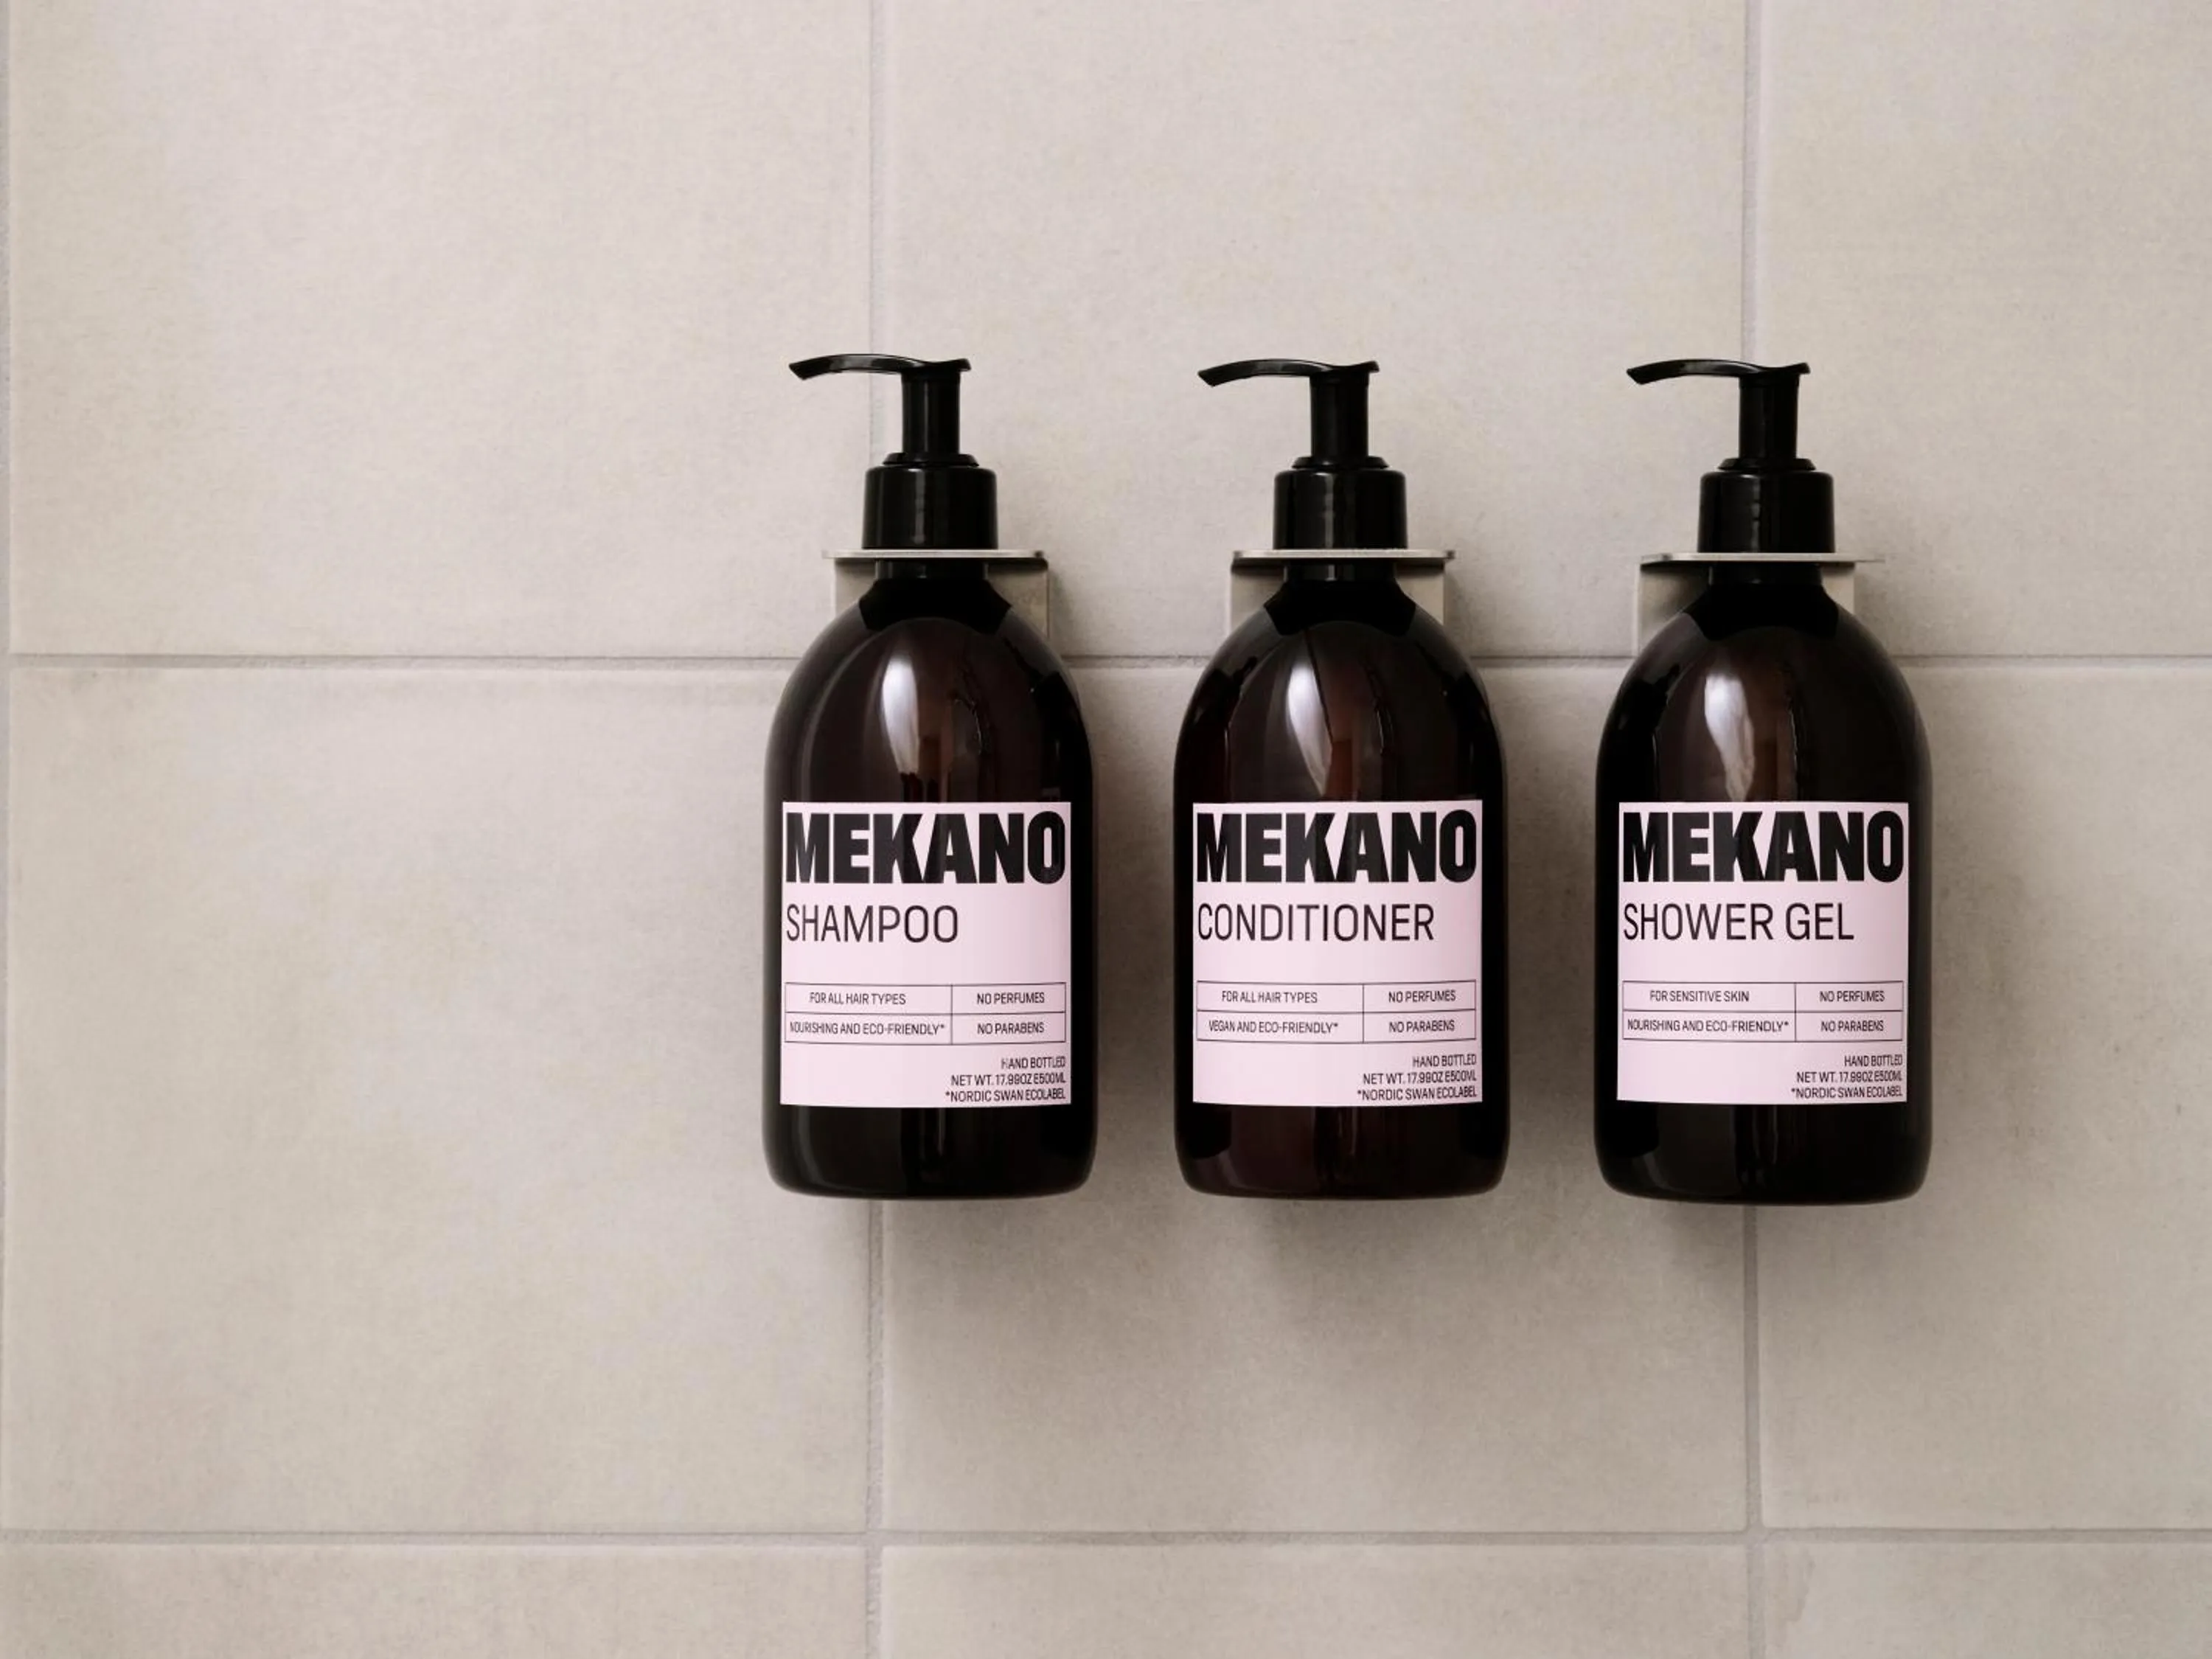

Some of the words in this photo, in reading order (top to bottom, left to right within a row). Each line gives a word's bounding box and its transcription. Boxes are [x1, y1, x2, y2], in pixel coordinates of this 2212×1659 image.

[786, 811, 1065, 885] MEKANO
[1197, 810, 1476, 883] MEKANO
[1623, 811, 1904, 883] MEKANO
[786, 904, 958, 942] SHAMPOO
[1198, 903, 1434, 941] CONDITIONER
[1624, 903, 1773, 940] SHOWER
[1785, 903, 1854, 940] GEL
[810, 992, 827, 1004] FOR
[829, 993, 844, 1004] ALL
[846, 993, 870, 1005] HAIR
[872, 993, 906, 1005] TYPES
[977, 993, 992, 1004] NO
[993, 992, 1045, 1004] PERFUMES
[1222, 991, 1238, 1002] FOR
[1239, 992, 1256, 1003] ALL
[1258, 992, 1281, 1003] HAIR
[1284, 992, 1318, 1004] TYPES
[1388, 992, 1403, 1003] NO
[1405, 990, 1455, 1002] PERFUMES
[1650, 991, 1668, 1001] FOR
[1669, 991, 1722, 1002] SENSITIVE
[1724, 991, 1749, 1001] SKIN
[1820, 991, 1834, 1002] NO
[1837, 990, 1885, 1001] PERFUMES
[790, 1022, 838, 1034] NOURISHING
[840, 1023, 861, 1034] AND
[978, 1023, 992, 1034] NO
[995, 1022, 1045, 1034] PARABENS
[1209, 1020, 1235, 1032] VEGAN
[1237, 1022, 1256, 1032] AND
[1389, 1022, 1404, 1032] NO
[1406, 1020, 1455, 1032] PARABENS
[1627, 1020, 1680, 1032] NOURISHING
[1682, 1021, 1703, 1032] AND
[1821, 1021, 1836, 1032] NO
[1838, 1020, 1884, 1032] PARABENS
[1001, 1057, 1028, 1069] HAND
[1031, 1056, 1065, 1068] BOTTLED
[1413, 1056, 1439, 1067] HAND
[1442, 1054, 1477, 1066] BOTTLED
[1844, 1056, 1869, 1066] HAND
[1871, 1054, 1902, 1066] BOTTLED
[951, 1075, 973, 1085] NET
[1363, 1074, 1383, 1085] NET
[1797, 1072, 1816, 1082] NET
[994, 1090, 1023, 1101] SWAN
[1026, 1088, 1065, 1100] ECOLABEL
[1405, 1088, 1435, 1099] SWAN
[1438, 1085, 1477, 1099] ECOLABEL
[1837, 1087, 1865, 1098] SWAN
[1867, 1085, 1902, 1098] ECOLABEL
